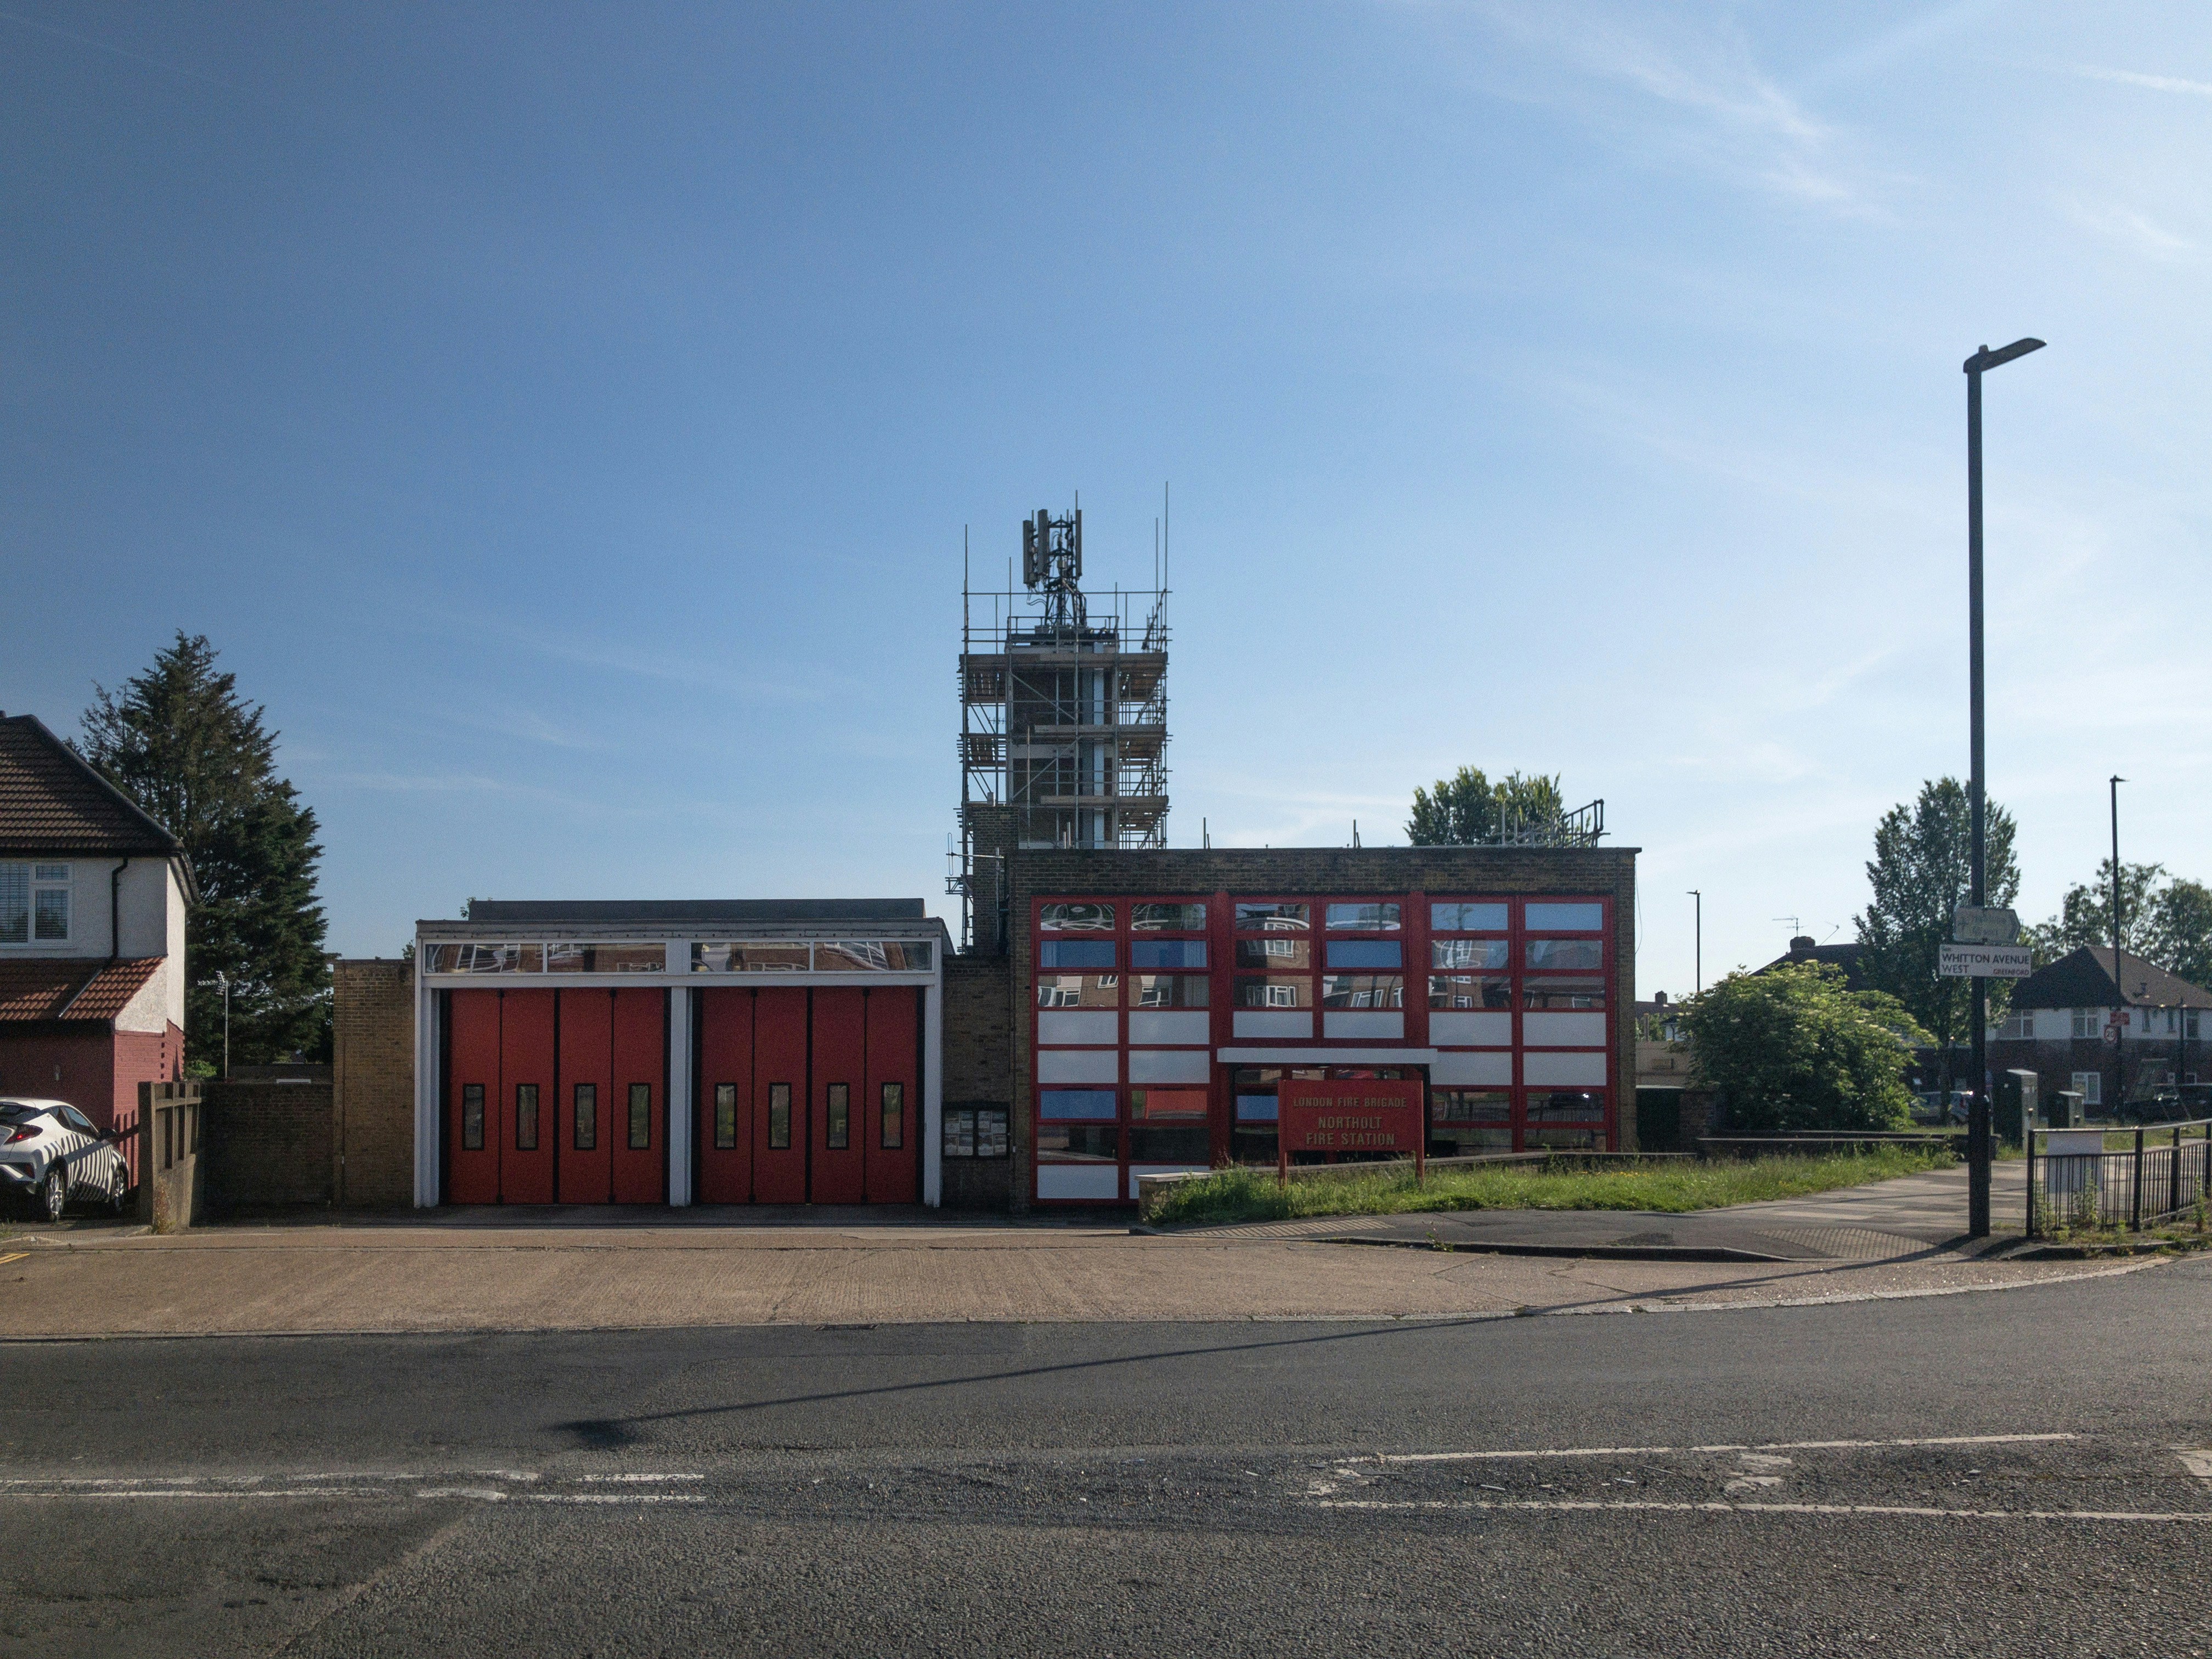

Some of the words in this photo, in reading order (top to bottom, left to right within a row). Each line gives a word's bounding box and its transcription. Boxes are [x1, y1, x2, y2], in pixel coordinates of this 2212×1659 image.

[1942, 953, 1990, 963] WHITTON
[1991, 955, 2030, 964] AVENUE
[1942, 964, 1970, 973] WEST
[1293, 1097, 1333, 1108] LONDON
[1338, 1097, 1359, 1108] FIRE
[1364, 1097, 1407, 1108] BRIGADE
[1318, 1116, 1383, 1129] NORTHOLT
[1306, 1132, 1334, 1145] FIRE
[1341, 1133, 1395, 1146] STATION
